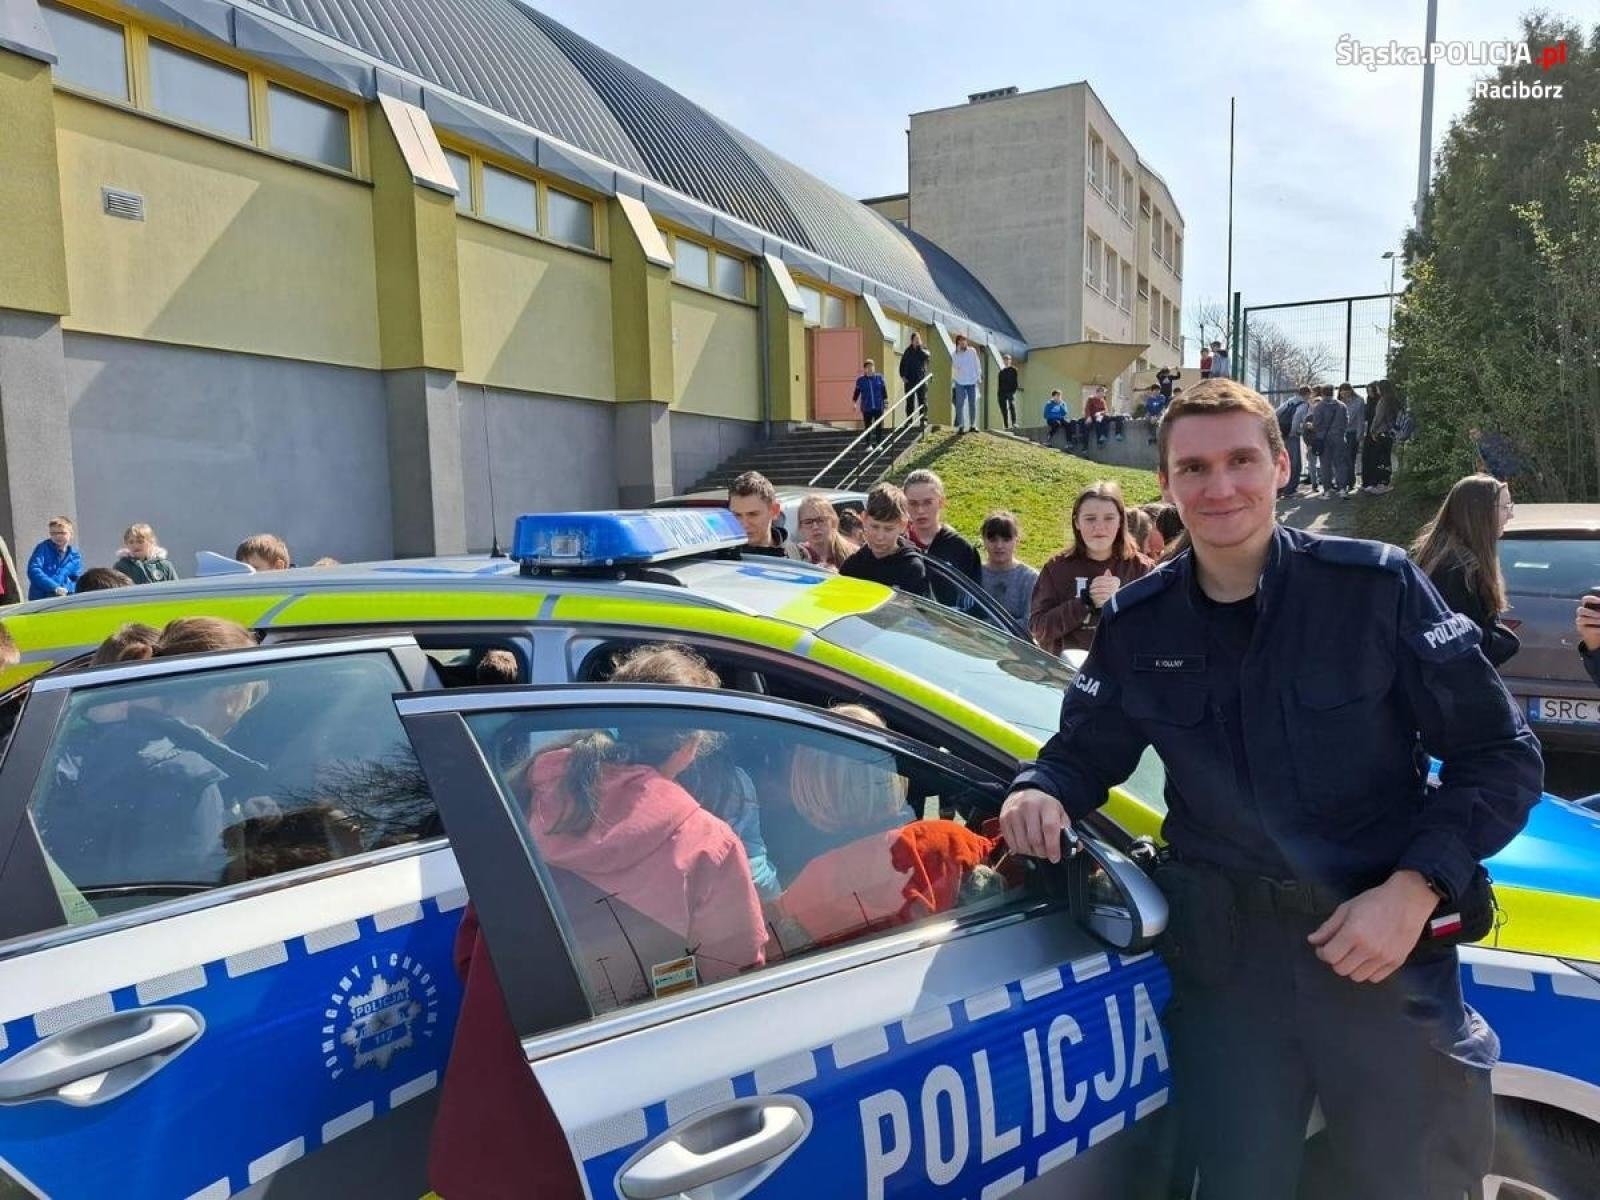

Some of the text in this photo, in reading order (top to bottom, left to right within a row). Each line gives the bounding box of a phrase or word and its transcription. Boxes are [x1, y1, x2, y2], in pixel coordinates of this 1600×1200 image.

[1423, 615, 1473, 649] POLICJA
[1544, 700, 1589, 720] SRC
[859, 982, 1169, 1200] POLICJA
